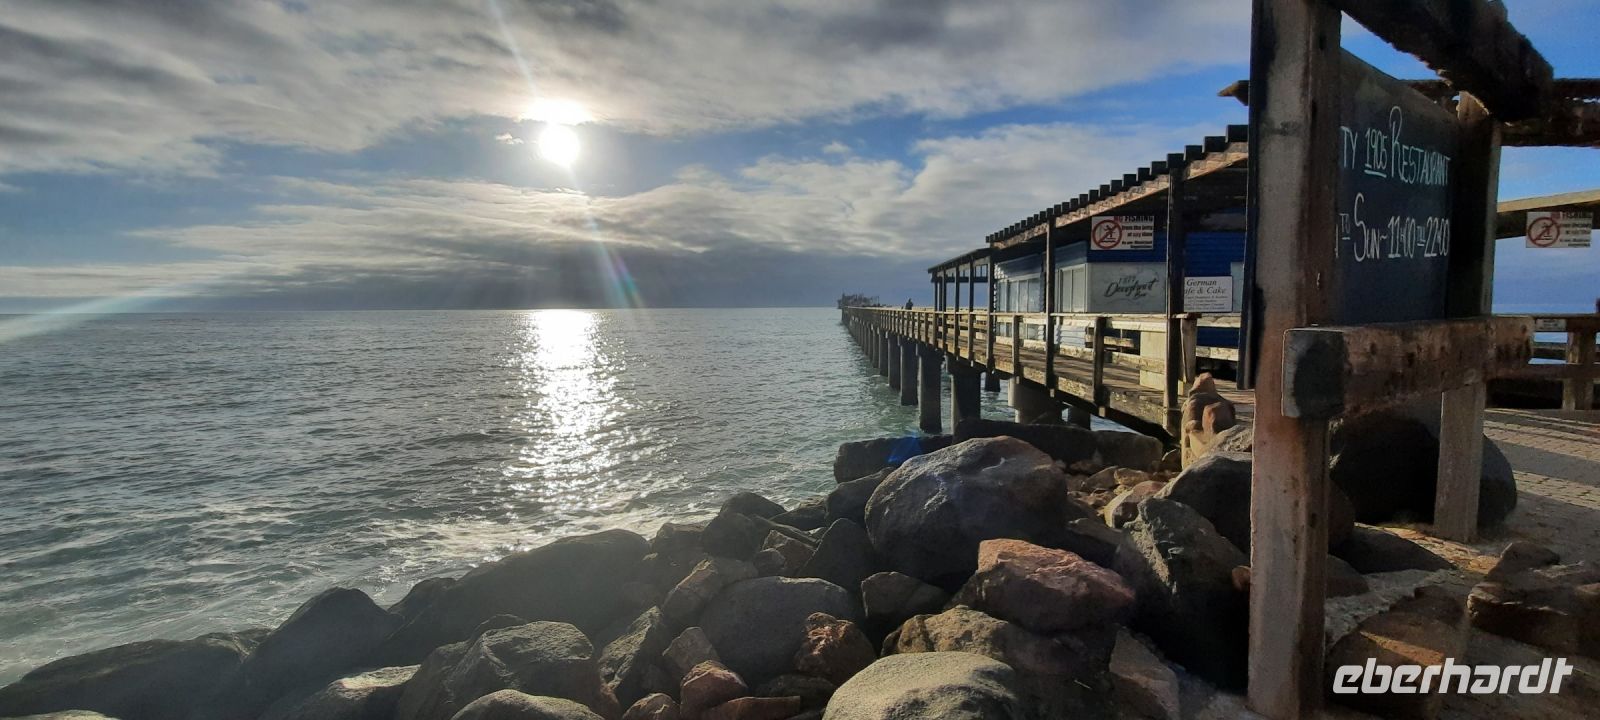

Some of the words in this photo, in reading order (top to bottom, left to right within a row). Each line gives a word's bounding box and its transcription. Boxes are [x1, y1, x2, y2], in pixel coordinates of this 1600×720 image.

[1364, 128, 1387, 170] 1905
[1389, 106, 1451, 187] RESTAURANT
[1186, 278, 1217, 287] German
[1206, 286, 1226, 294] Cake
